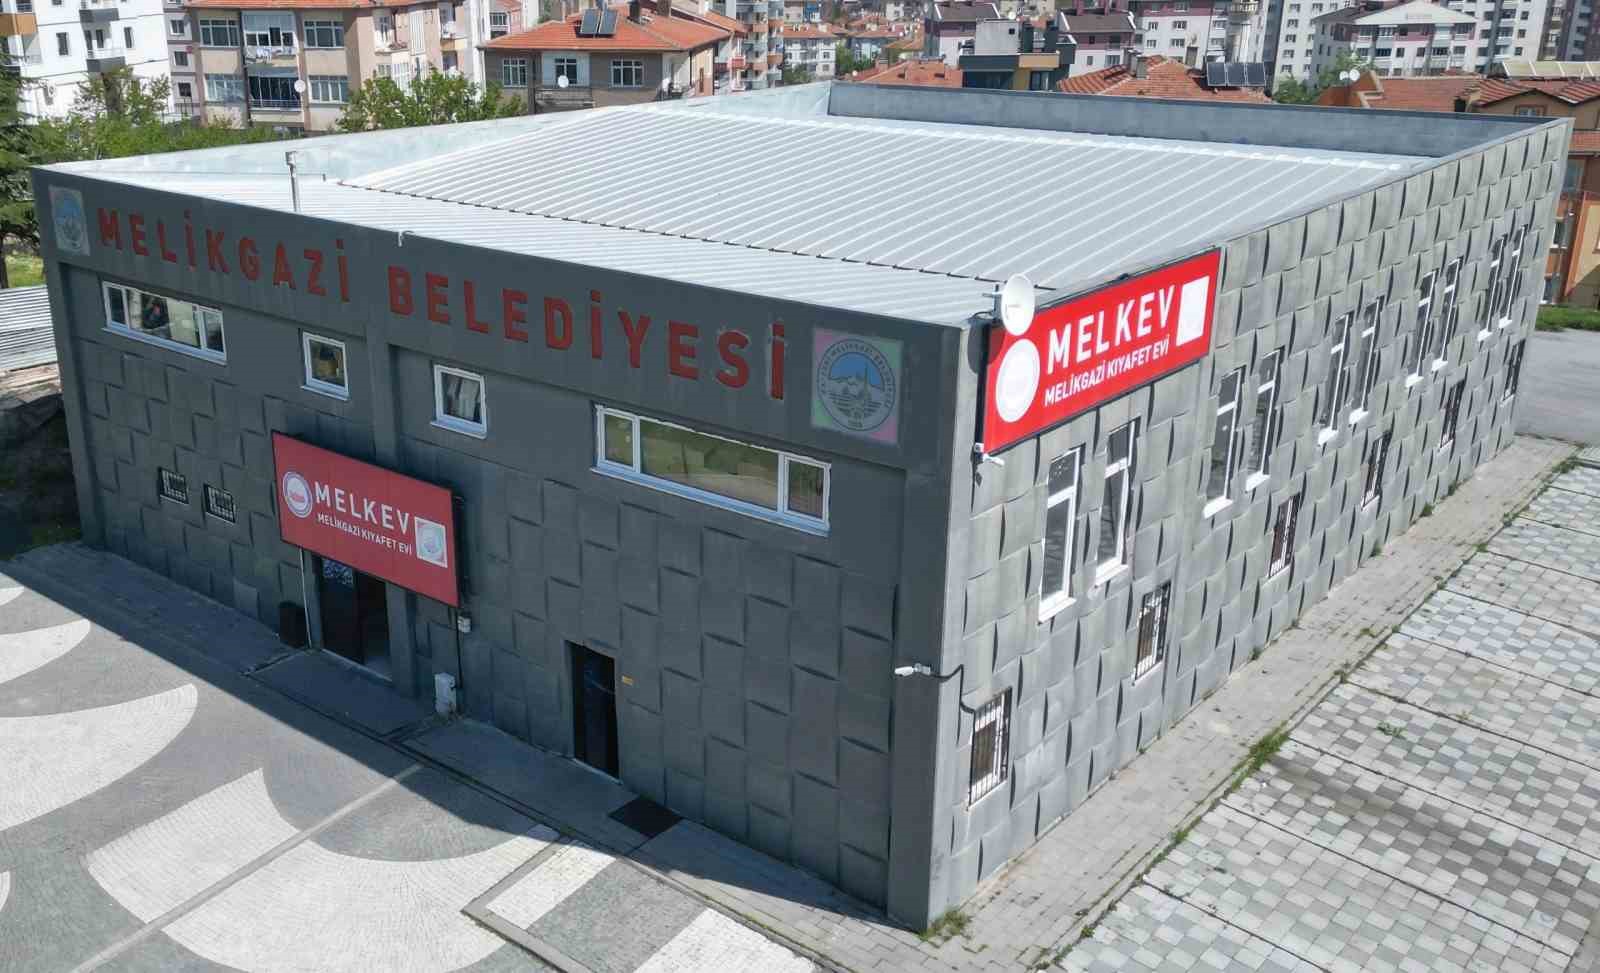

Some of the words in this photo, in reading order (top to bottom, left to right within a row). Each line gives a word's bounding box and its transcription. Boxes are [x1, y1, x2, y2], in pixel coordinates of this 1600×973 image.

[97, 207, 351, 302] MELİKGAZİ
[386, 265, 785, 400] BELEDİYESİ
[1046, 284, 1175, 376] MELKEV
[1045, 360, 1105, 406] MELİKGAZİ
[1106, 345, 1152, 379] KIYAFET
[1153, 334, 1170, 360] EVİ
[315, 481, 409, 534] MELKEV
[361, 529, 397, 550] KIYAFET
